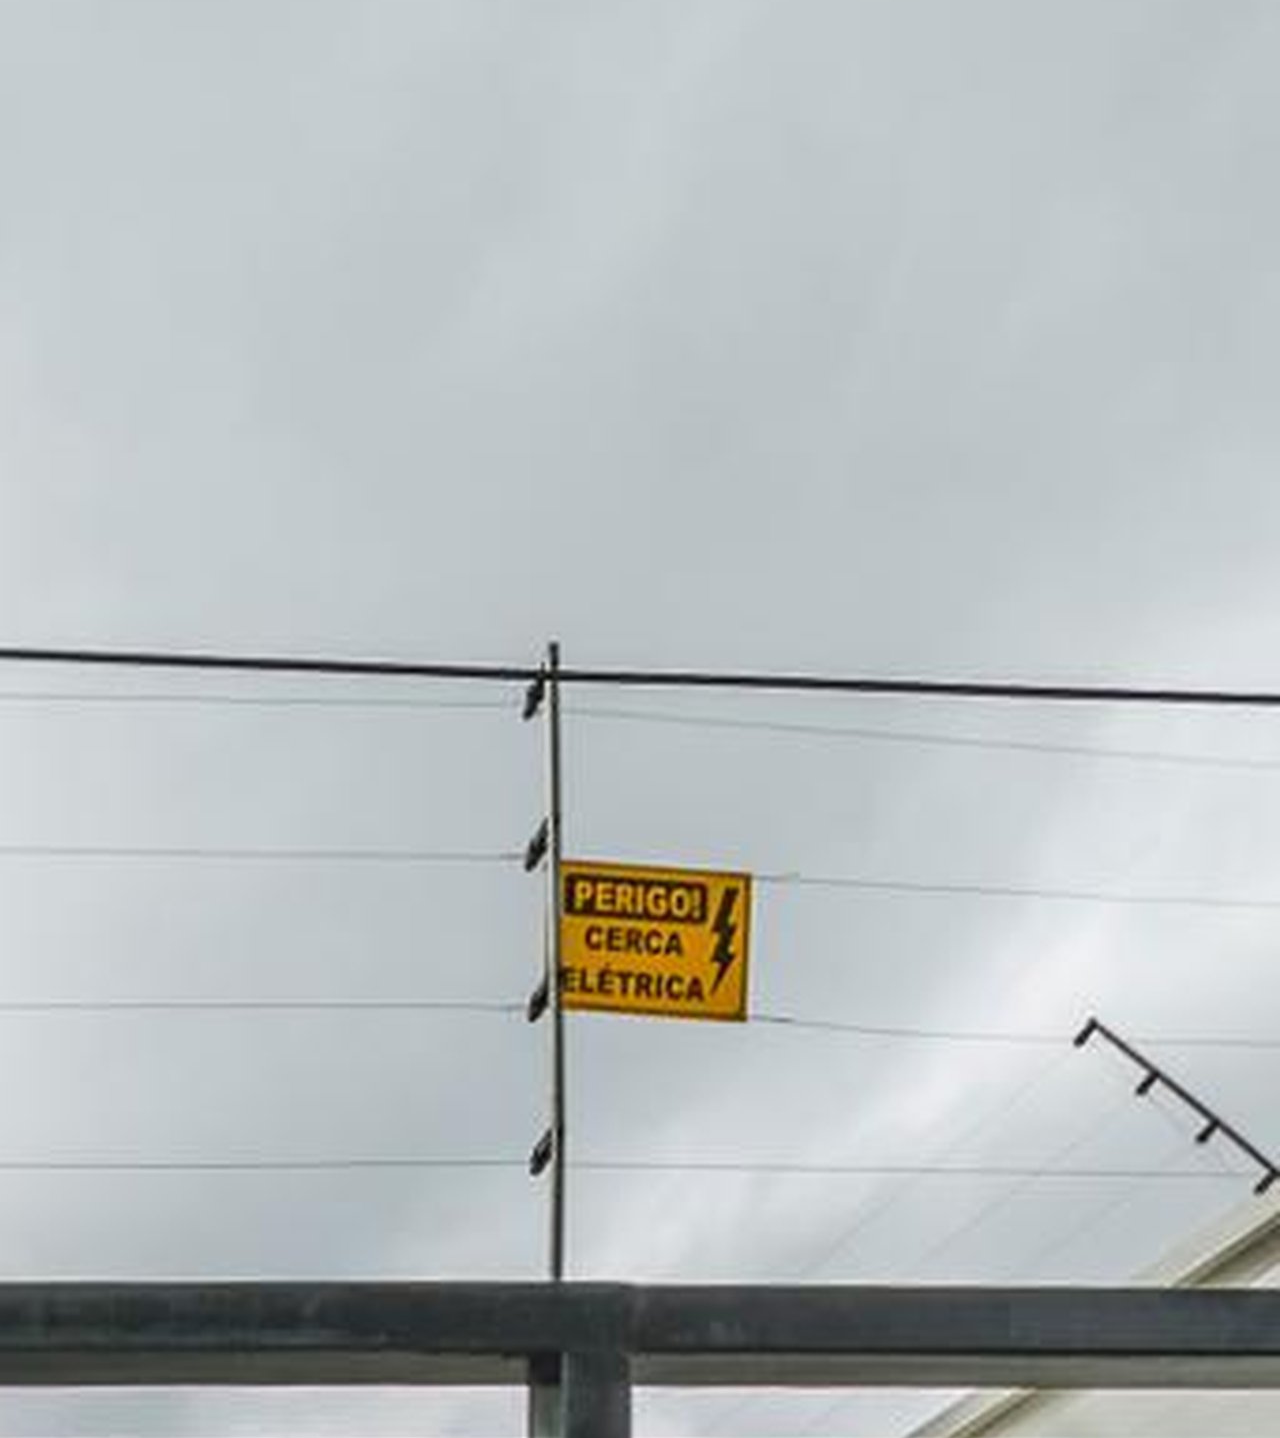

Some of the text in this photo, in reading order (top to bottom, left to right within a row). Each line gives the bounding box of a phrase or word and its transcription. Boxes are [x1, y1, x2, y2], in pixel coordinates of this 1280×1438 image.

[573, 880, 702, 920] PERIGO!
[584, 924, 683, 956] CERCA
[557, 963, 705, 1002] ELÉTRICA
